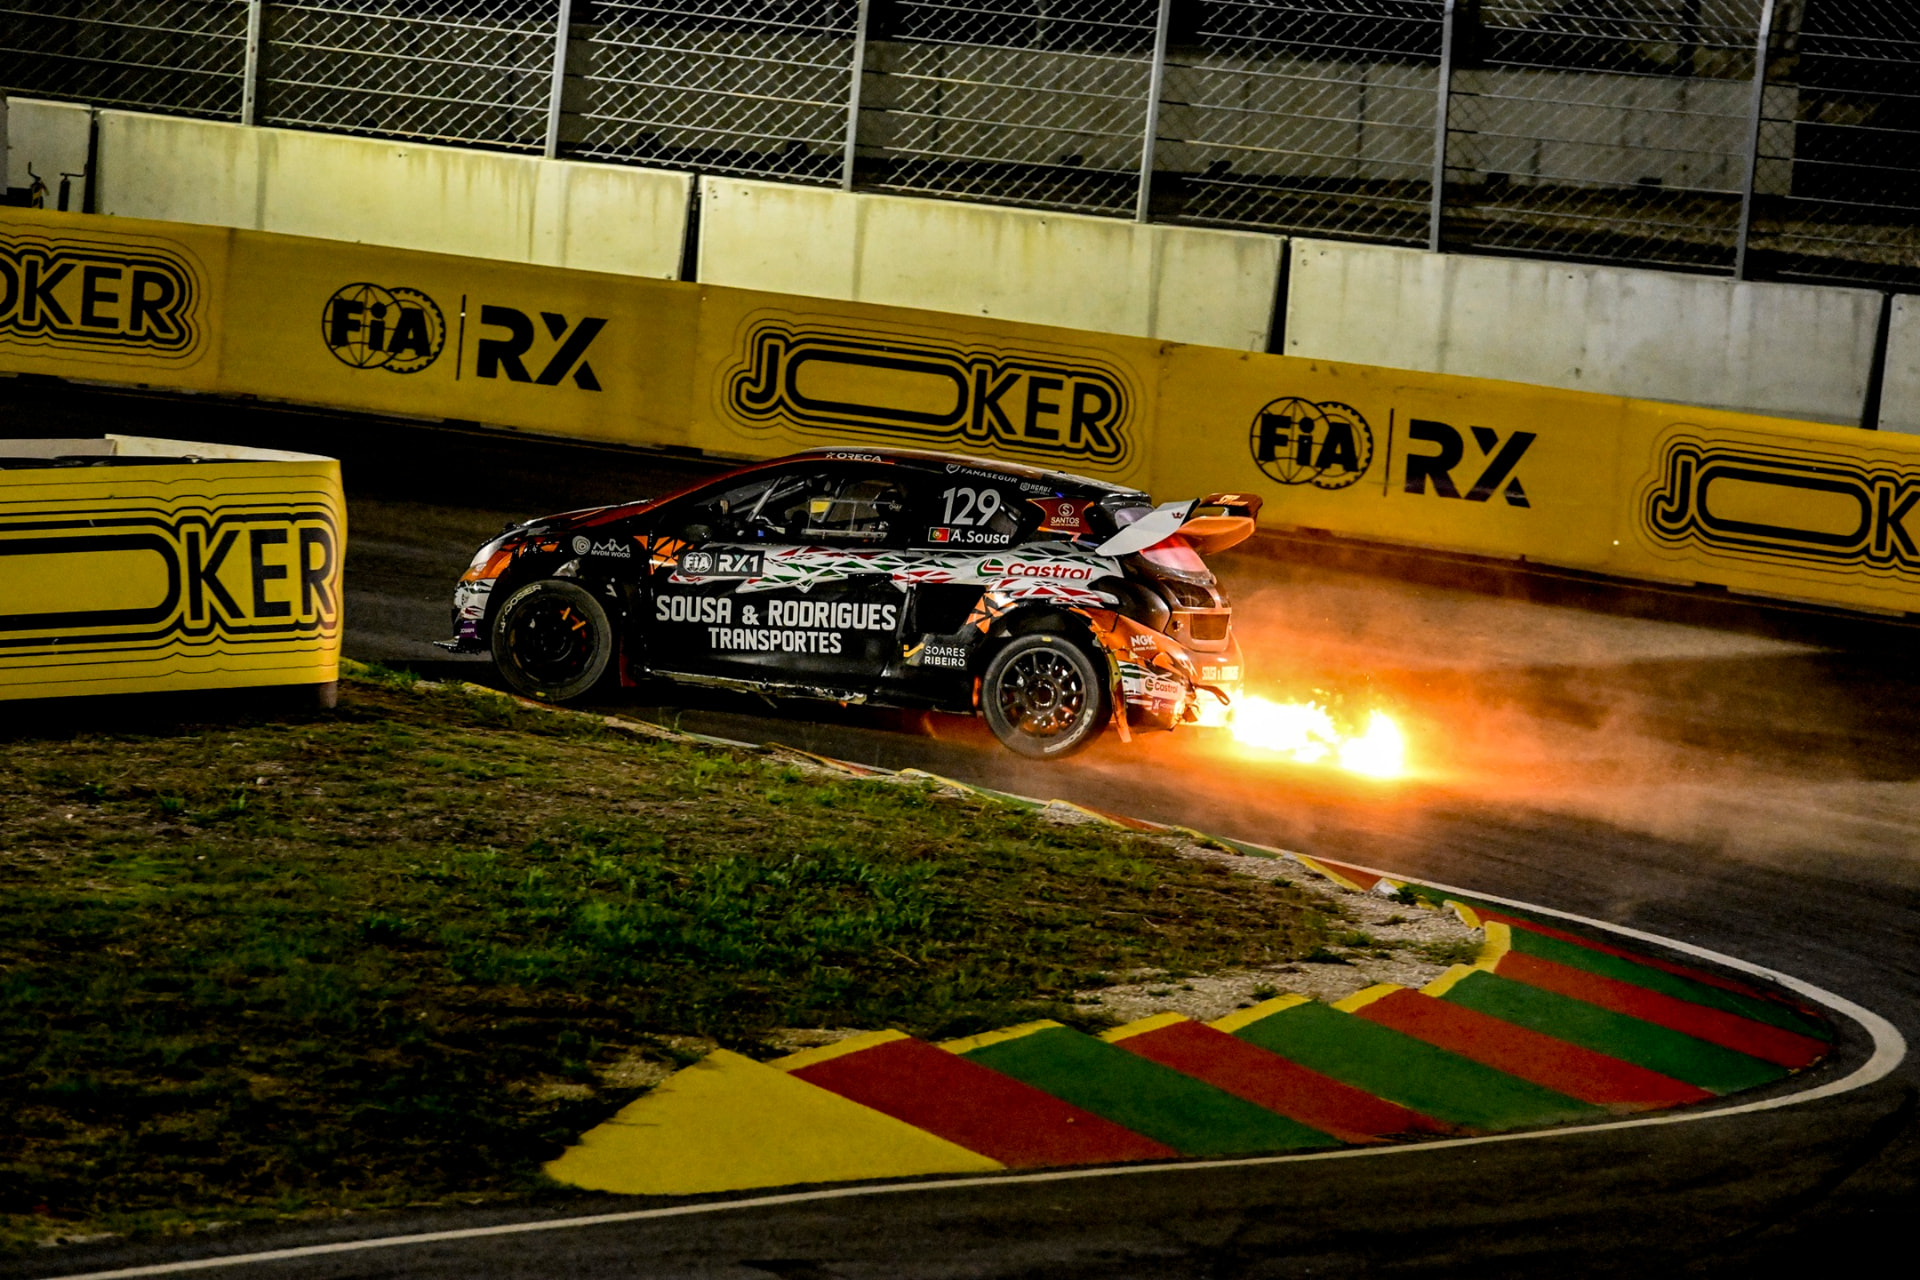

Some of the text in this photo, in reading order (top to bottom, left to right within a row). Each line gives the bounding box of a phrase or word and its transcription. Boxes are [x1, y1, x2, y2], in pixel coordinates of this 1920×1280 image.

[0, 258, 175, 335] KER
[476, 304, 609, 392] RX
[745, 342, 1114, 448] JOKER
[836, 452, 882, 462] ORECA
[1403, 418, 1538, 509] RX
[942, 487, 1001, 526] 129
[1661, 460, 1920, 558] JOK
[1050, 516, 1080, 524] SANTOS
[611, 551, 631, 559] WOOD
[718, 554, 759, 573] RX1
[0, 525, 337, 633] OKER
[1007, 562, 1092, 581] Castrol
[656, 595, 897, 631] SOUSA & RODRIGUES
[708, 627, 842, 654] TRANSPORTES
[924, 646, 966, 657] SOARES
[1130, 634, 1156, 648] NGK
[924, 655, 966, 667] RIBEIRO
[1154, 681, 1179, 694] Castrol
